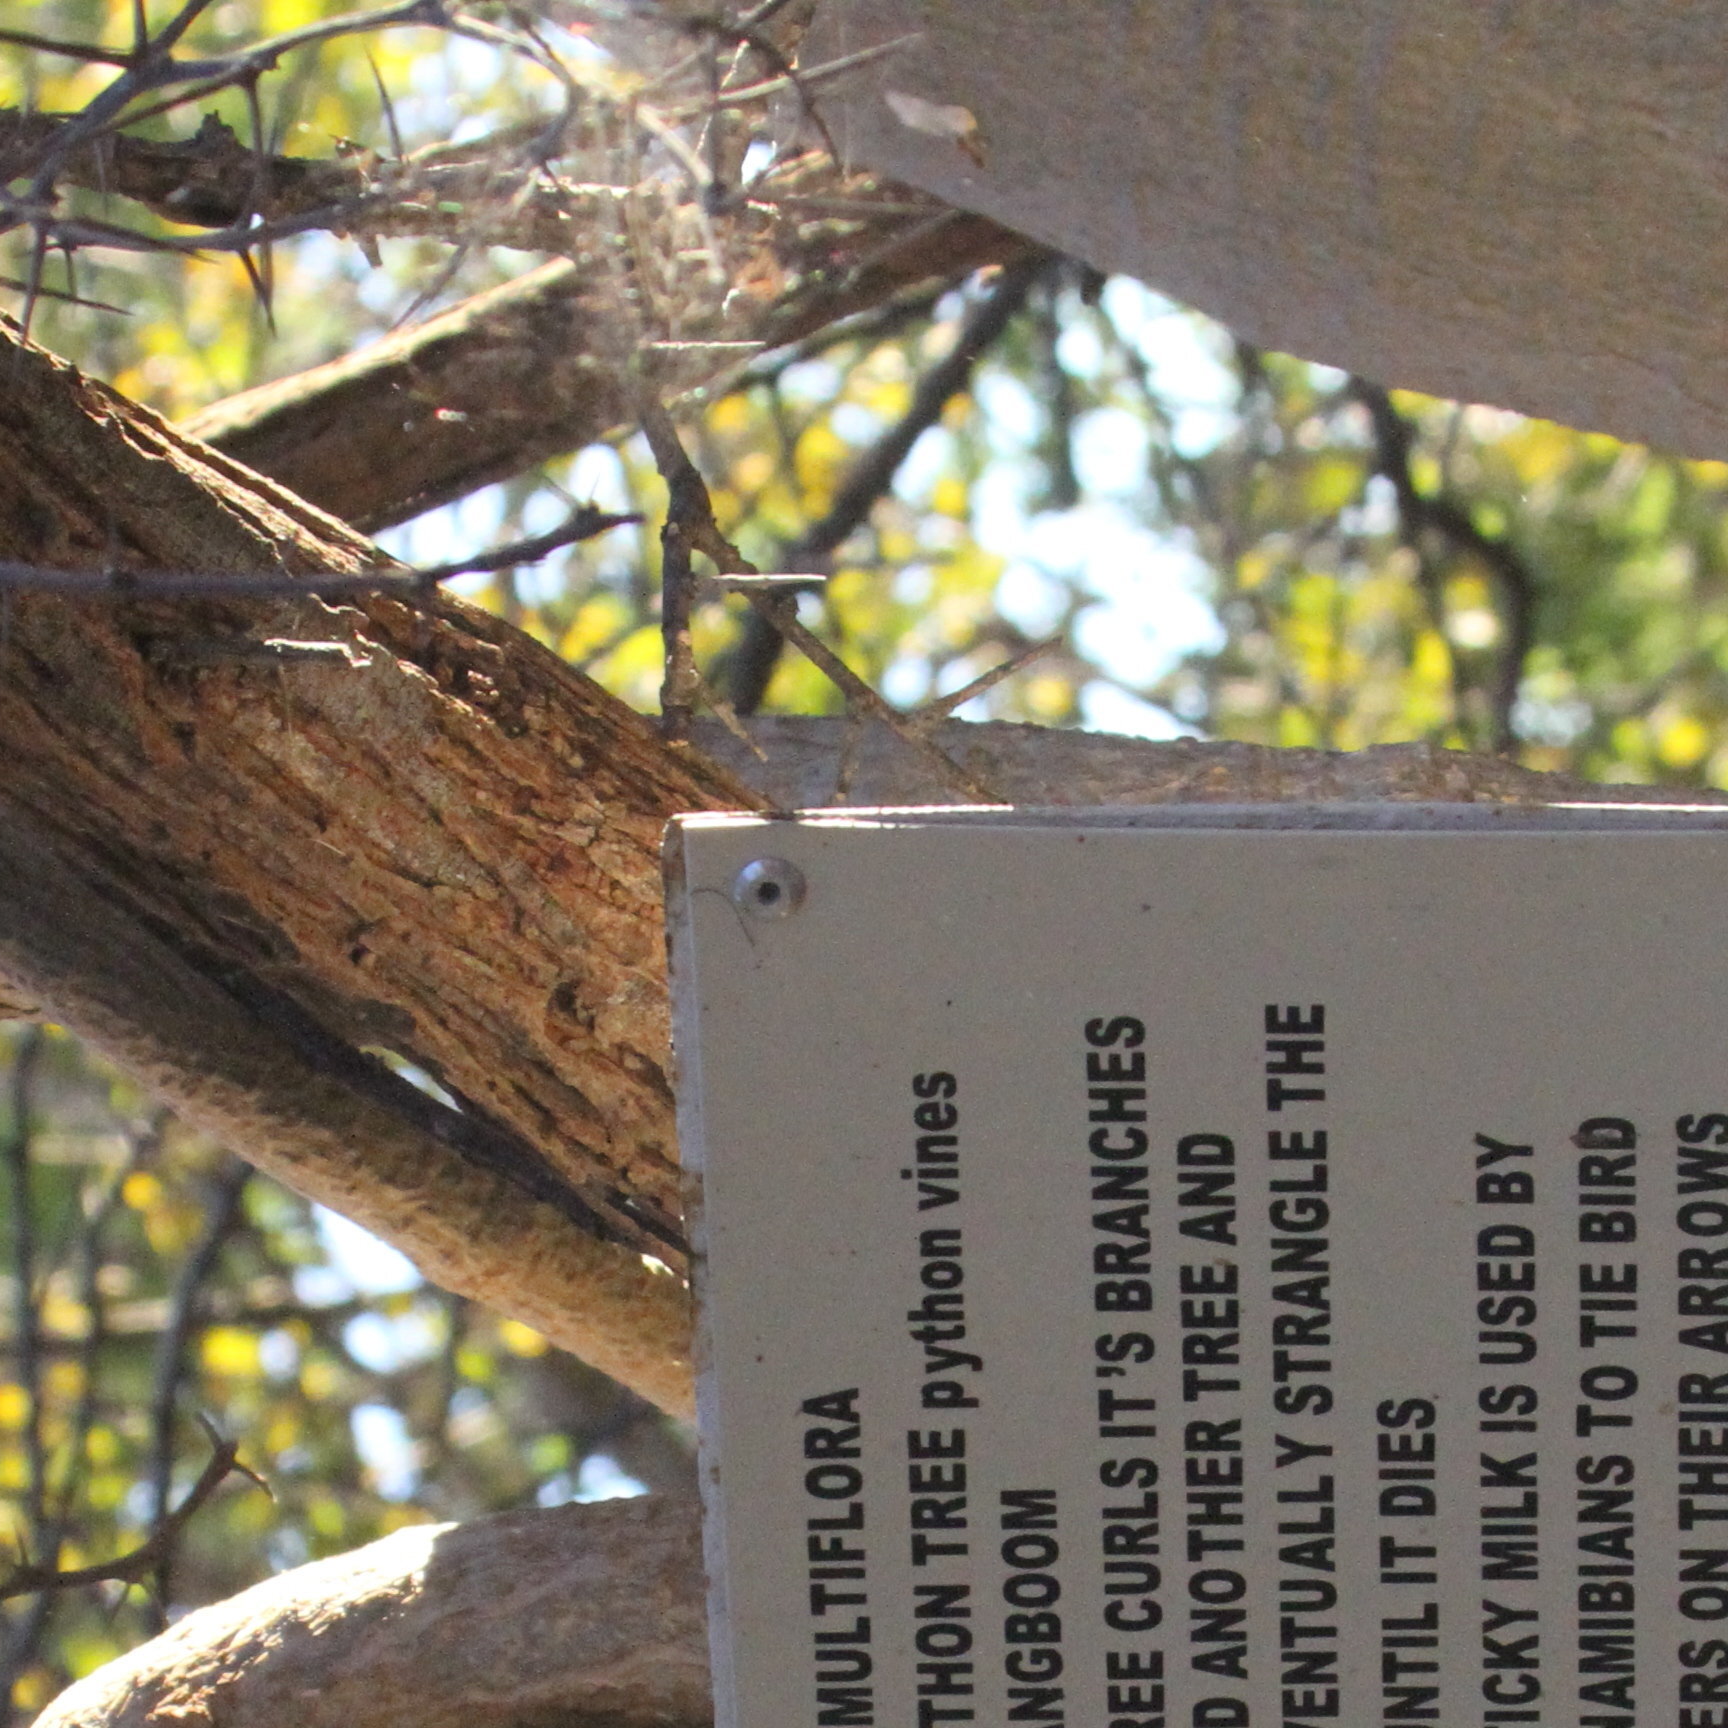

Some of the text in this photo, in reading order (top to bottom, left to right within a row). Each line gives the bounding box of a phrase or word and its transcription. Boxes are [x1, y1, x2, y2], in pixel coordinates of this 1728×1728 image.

[1264, 1004, 1326, 1112] THE
[900, 1071, 960, 1211] vines
[1084, 1016, 1153, 1312] BRANCHES
[1176, 1133, 1237, 1246] AND
[1474, 1133, 1535, 1204] BY
[1573, 1117, 1637, 1243] BIRD
[907, 1229, 983, 1409] python
[1179, 1264, 1241, 1402] TREE
[1268, 1130, 1334, 1416] STRANGLE
[1476, 1224, 1538, 1365] USED
[1579, 1264, 1638, 1348] TIE
[1376, 1398, 1437, 1517] DIES
[1478, 1384, 1538, 1433] IS
[1576, 1365, 1639, 1437] TO
[801, 1388, 874, 1726] MULTIFLORA
[907, 1428, 968, 1566] TREE
[1099, 1457, 1162, 1632] CURLS
[1184, 1419, 1248, 1679] ANOTHER
[1379, 1536, 1437, 1584] IT
[1480, 1452, 1539, 1580] MILK
